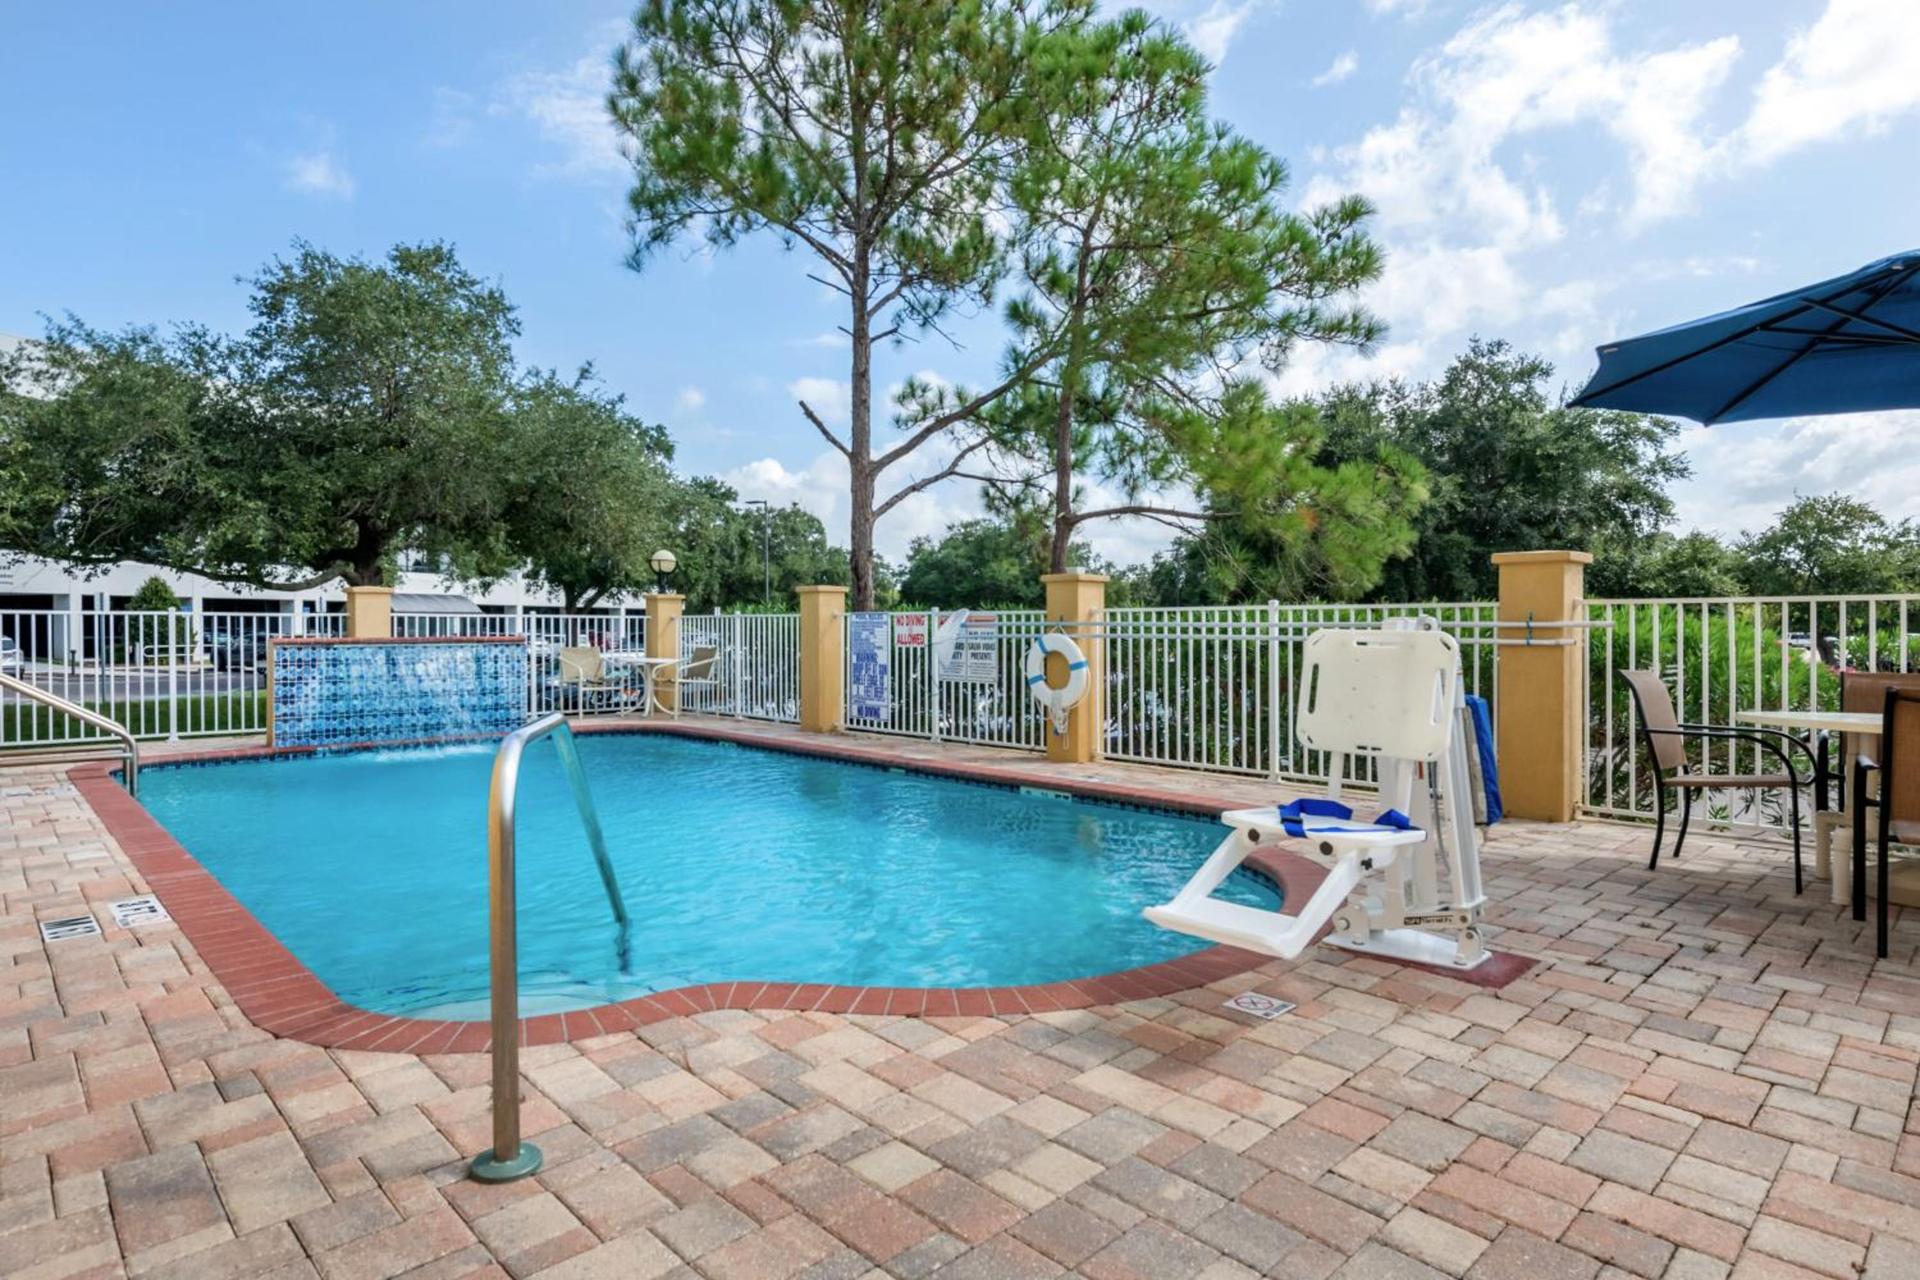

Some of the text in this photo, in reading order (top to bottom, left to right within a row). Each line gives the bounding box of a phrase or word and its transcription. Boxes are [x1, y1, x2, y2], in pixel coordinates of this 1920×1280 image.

[896, 615, 904, 626] NO
[905, 615, 925, 626] DIVING
[897, 633, 925, 645] ALLOWED
